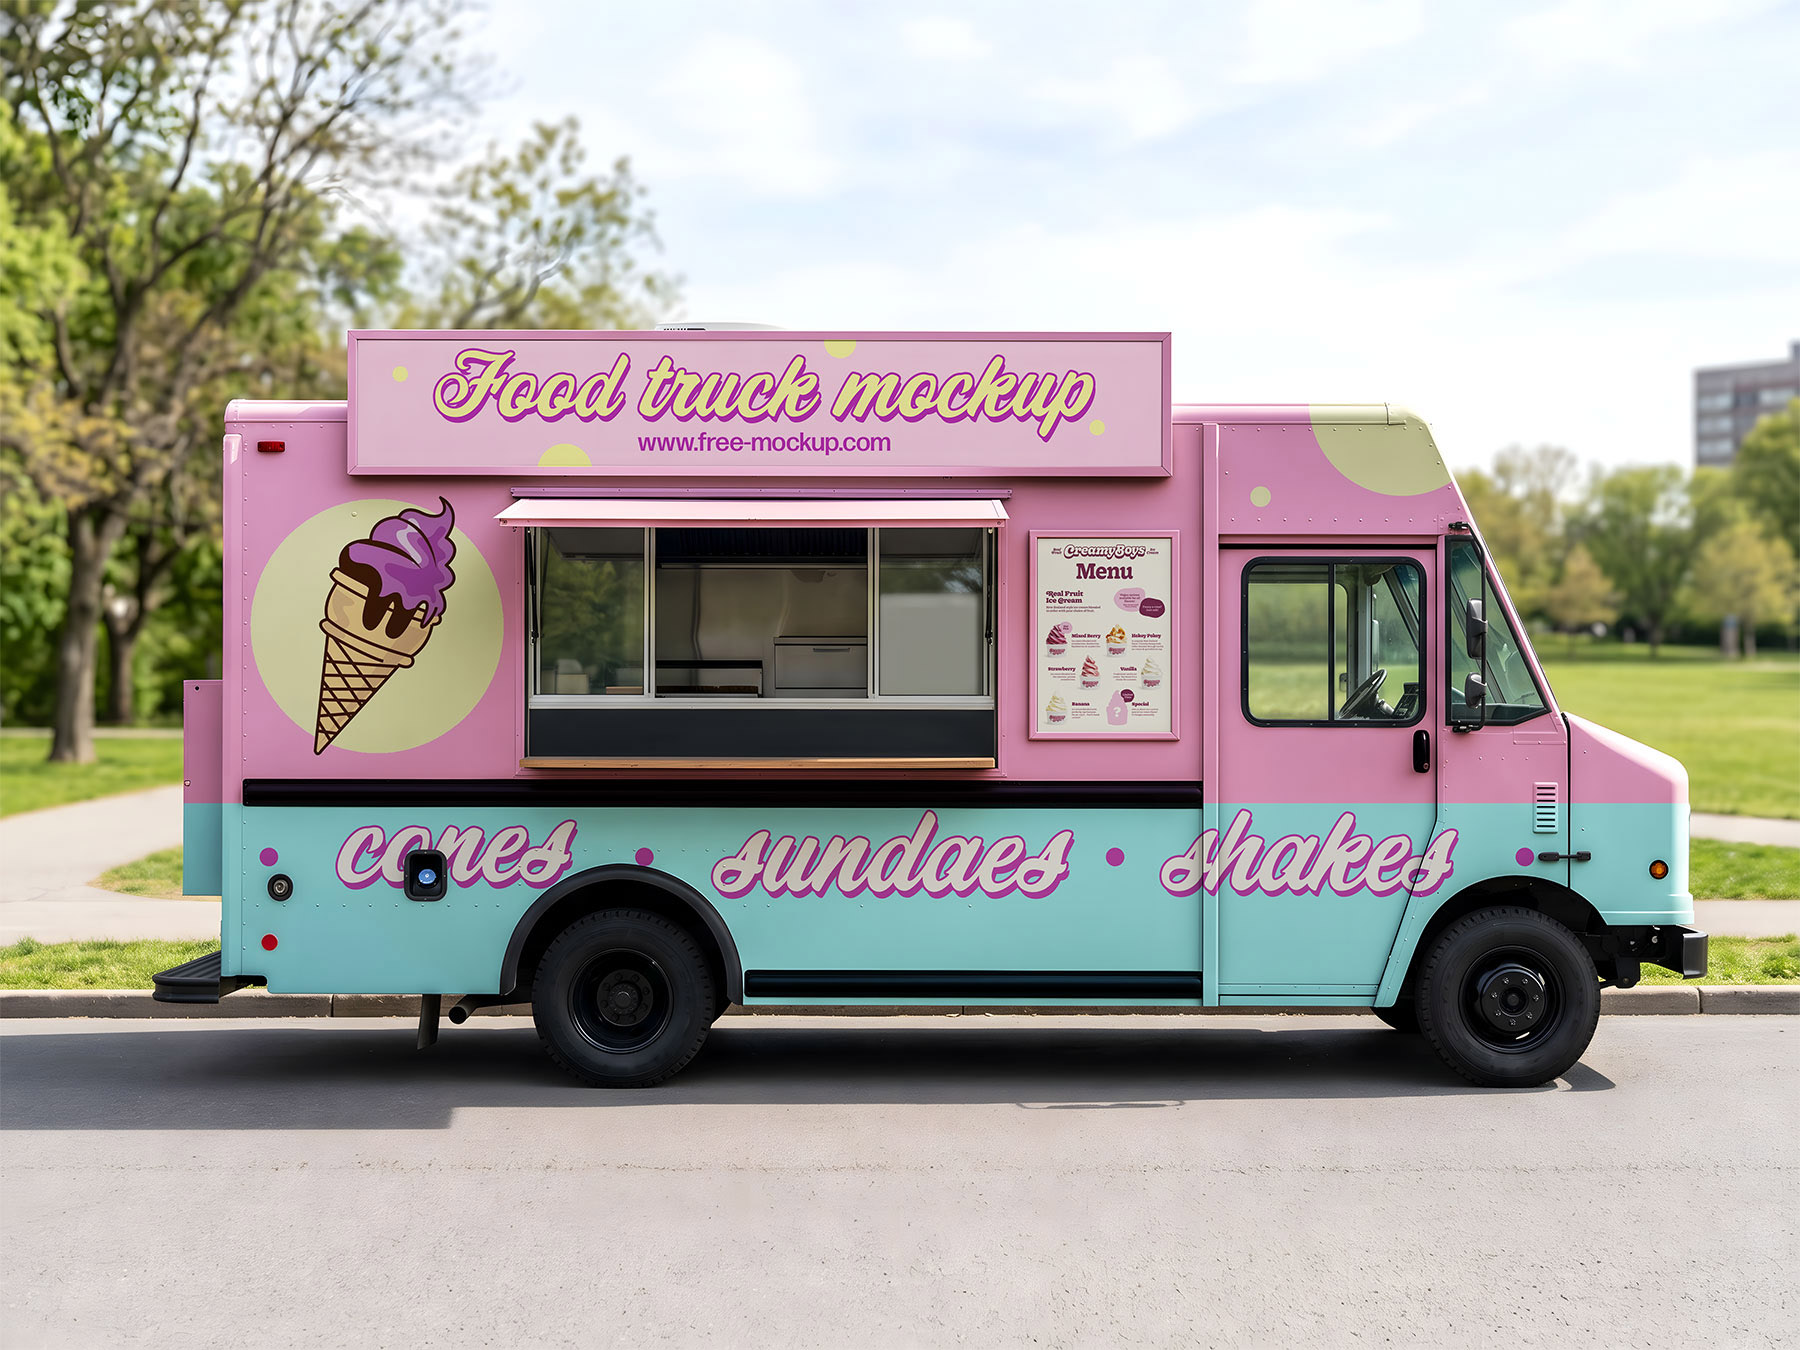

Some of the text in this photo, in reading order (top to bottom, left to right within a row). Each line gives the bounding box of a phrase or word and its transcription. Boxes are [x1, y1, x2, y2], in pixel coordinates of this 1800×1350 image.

[433, 348, 1096, 442] Food truck mockup
[638, 432, 891, 456] www.free-mockup.com
[1064, 544, 1146, 559] CreamyBoys
[1076, 563, 1133, 579] Menu
[1046, 590, 1063, 598] Real
[335, 808, 1459, 899] cones sundaes shakes
